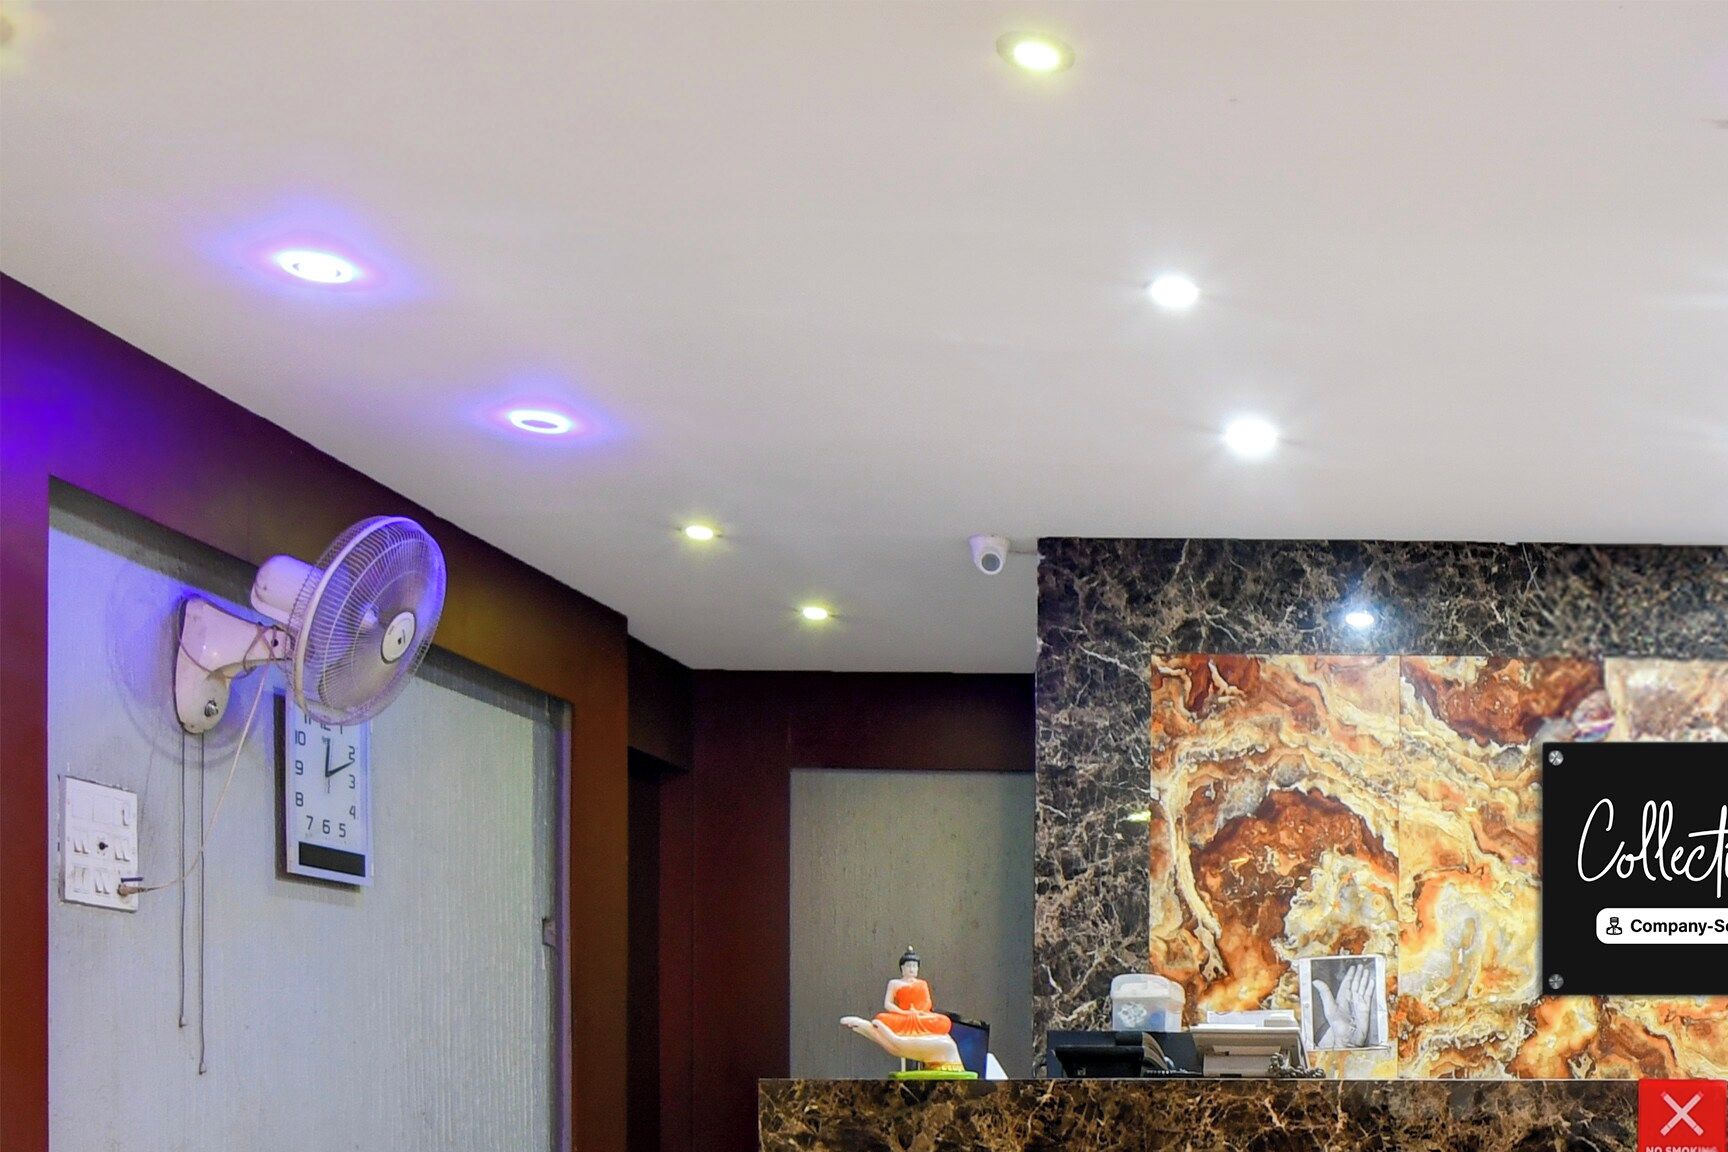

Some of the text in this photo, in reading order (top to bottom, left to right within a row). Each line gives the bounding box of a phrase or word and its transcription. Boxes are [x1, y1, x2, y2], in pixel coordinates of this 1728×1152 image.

[295, 730, 306, 746] 10
[348, 745, 356, 762] 2
[295, 760, 304, 776] 9
[348, 774, 356, 789] 3
[295, 792, 304, 807] 8
[349, 805, 356, 820] 4
[306, 815, 314, 830] 7
[322, 819, 331, 834] 6
[339, 823, 346, 838] 5
